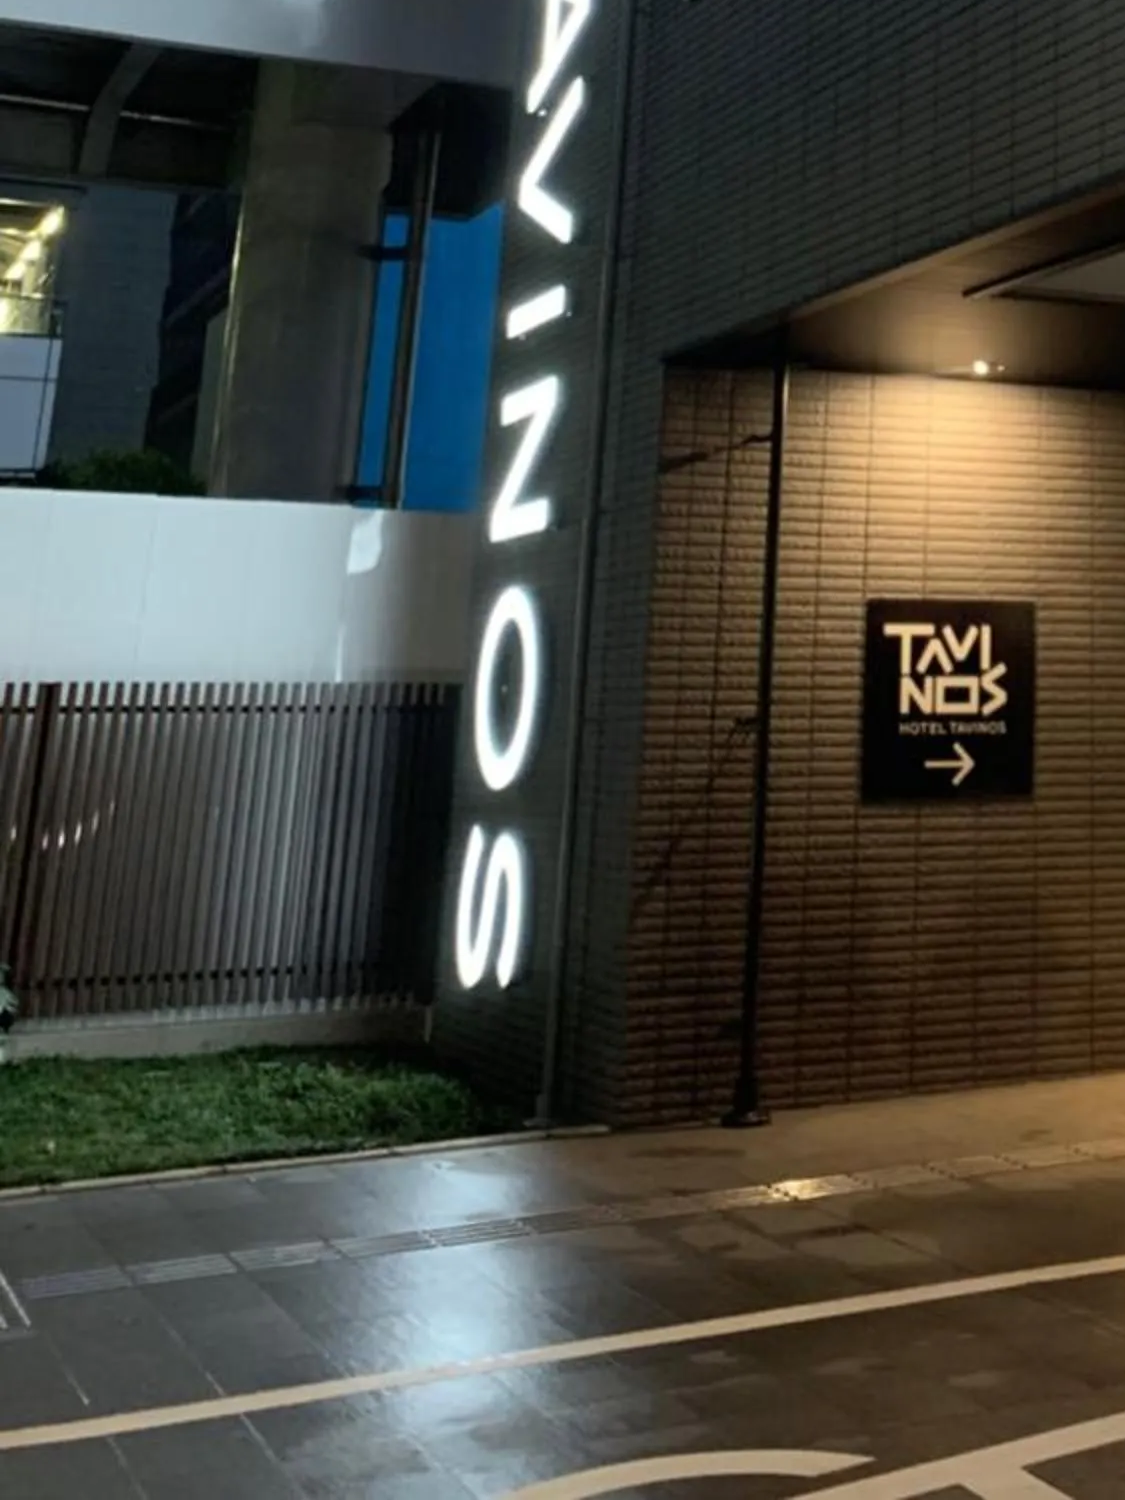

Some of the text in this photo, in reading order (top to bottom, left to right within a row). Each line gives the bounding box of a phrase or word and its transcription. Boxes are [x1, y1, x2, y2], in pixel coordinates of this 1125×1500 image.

[883, 622, 992, 674] TAVI
[900, 661, 1008, 716] NOS
[899, 721, 947, 735] HOTEL
